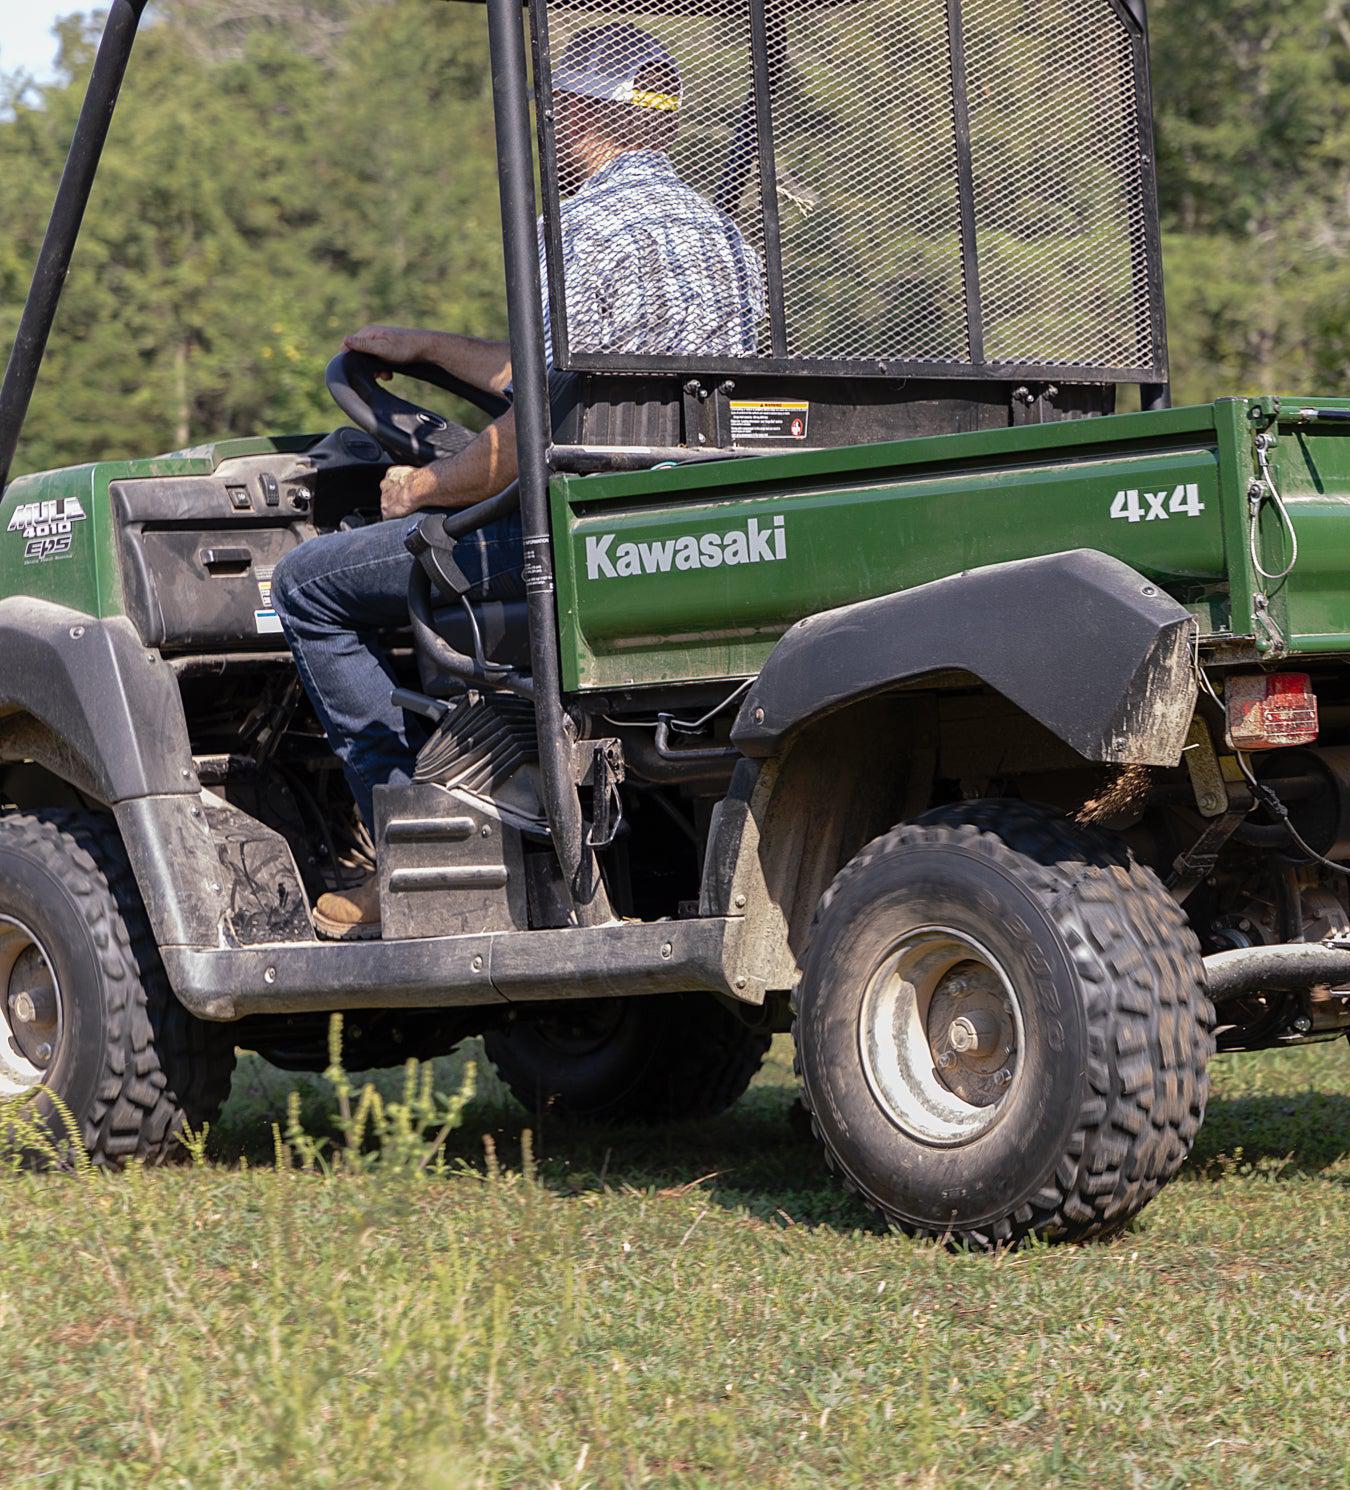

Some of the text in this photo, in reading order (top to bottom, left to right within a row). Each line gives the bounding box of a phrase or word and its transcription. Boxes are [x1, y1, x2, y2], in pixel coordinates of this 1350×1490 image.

[1110, 483, 1205, 522] 4x4
[22, 520, 72, 538] 4010
[585, 515, 787, 580] Kawasaki
